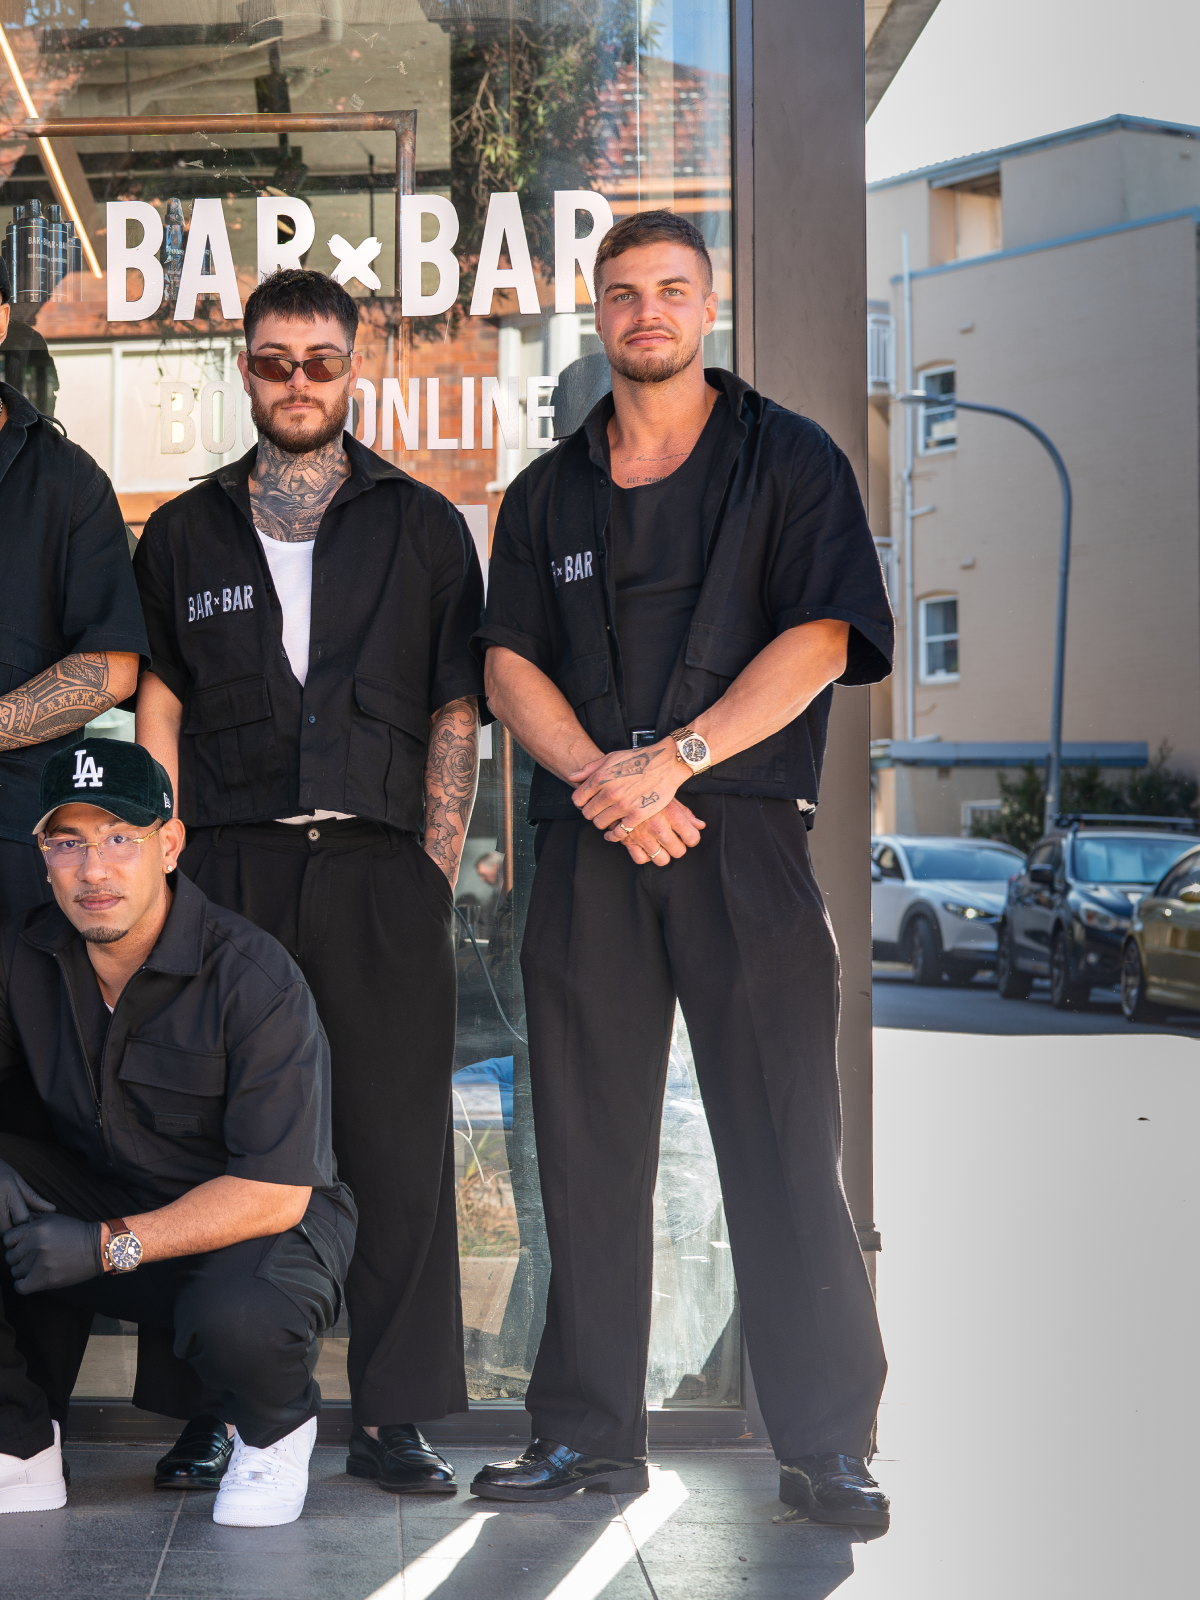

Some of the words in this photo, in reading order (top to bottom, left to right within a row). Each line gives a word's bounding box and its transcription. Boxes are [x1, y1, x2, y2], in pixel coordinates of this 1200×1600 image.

[160, 381, 258, 455] BO
[345, 376, 559, 450] ONLINE
[72, 749, 104, 788] LA
